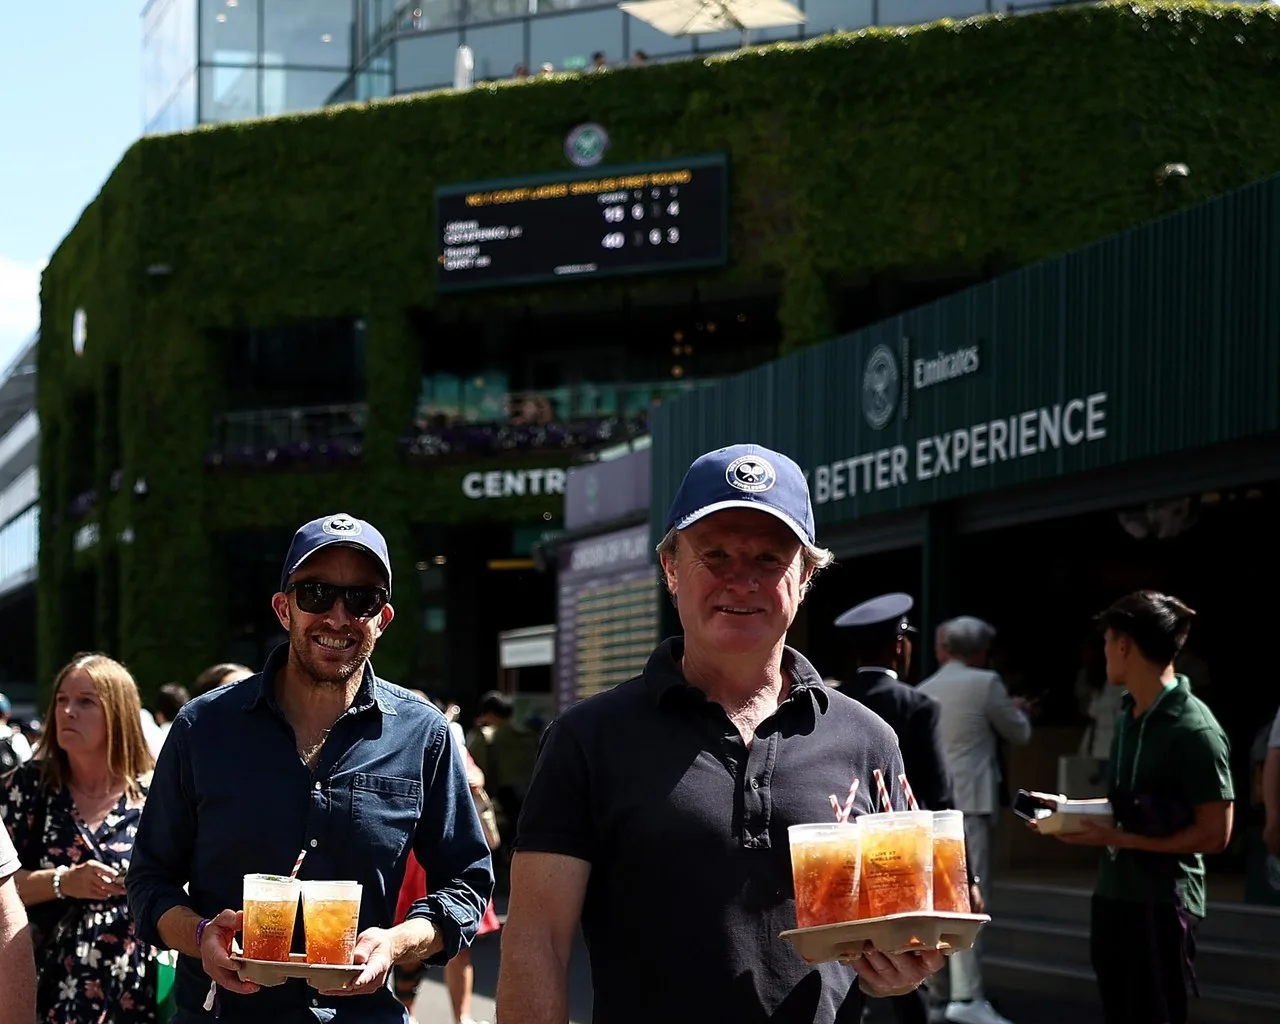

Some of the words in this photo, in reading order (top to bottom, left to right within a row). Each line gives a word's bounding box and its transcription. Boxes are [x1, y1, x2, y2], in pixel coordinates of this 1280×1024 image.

[913, 344, 980, 390] Emirates
[815, 443, 909, 505] BETTER
[915, 391, 1109, 482] EXPERIENCE
